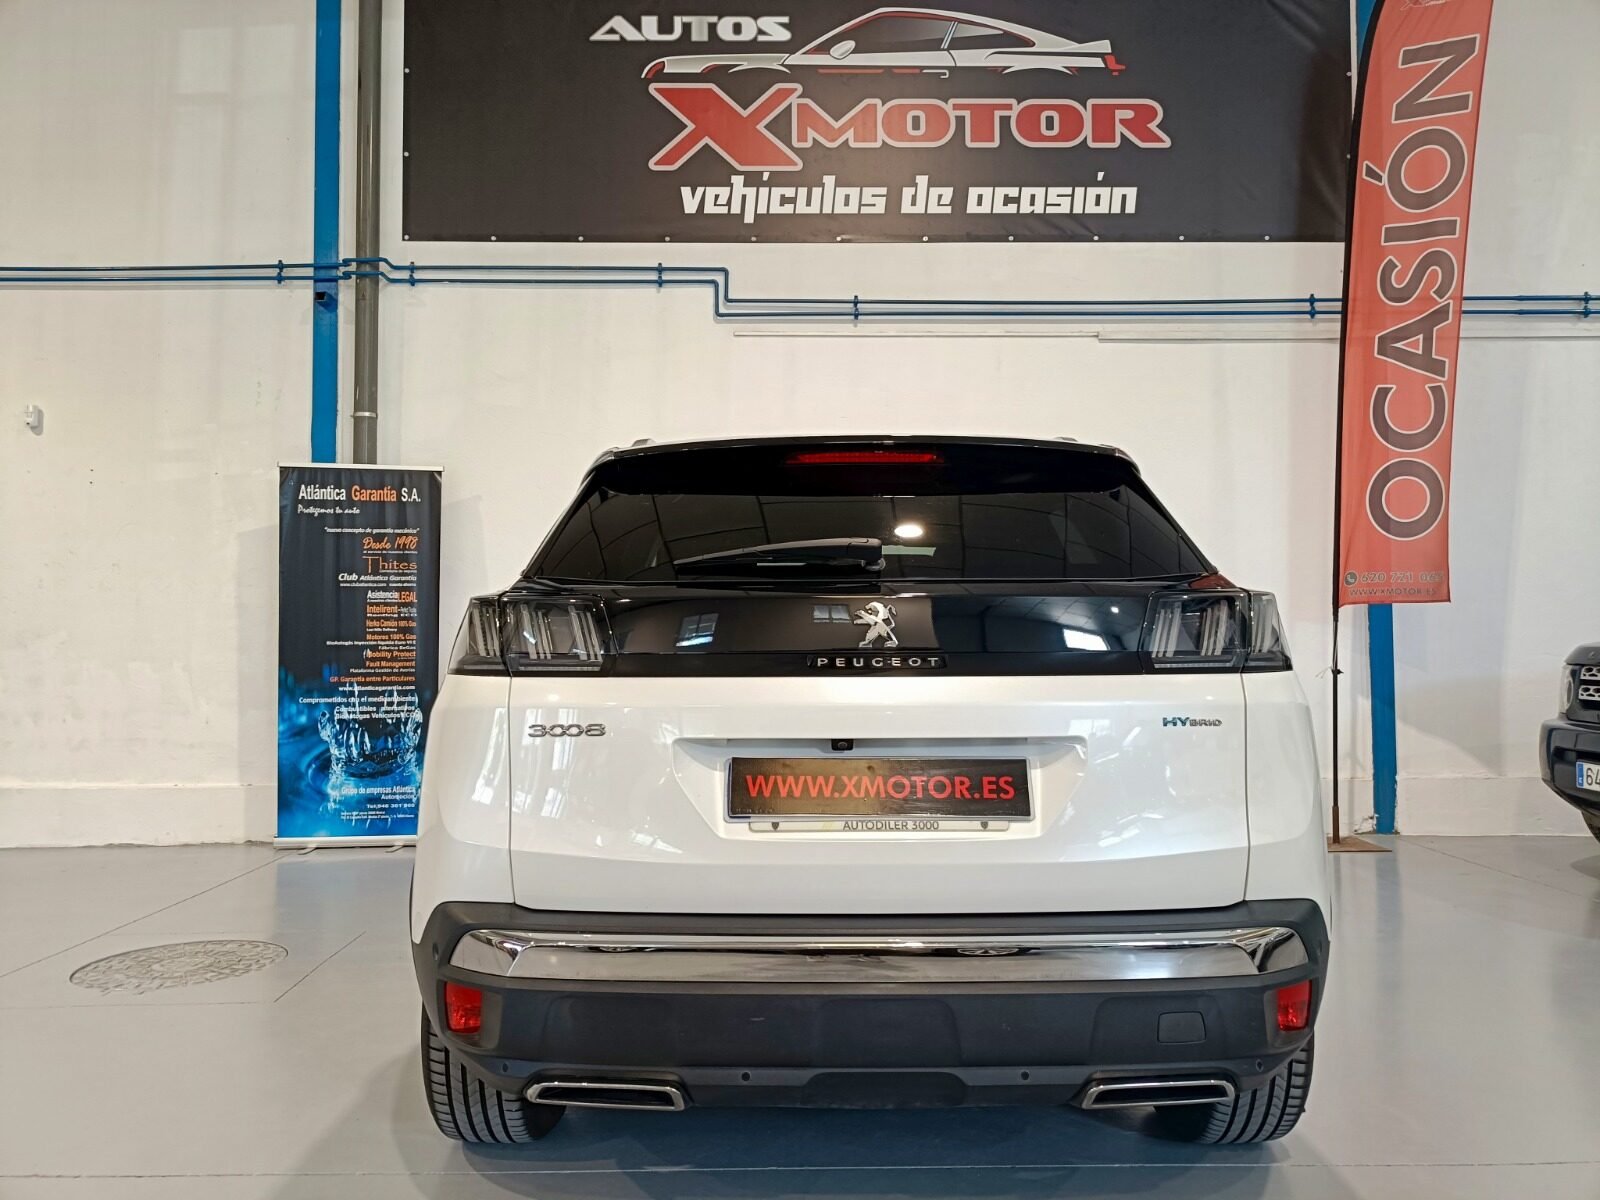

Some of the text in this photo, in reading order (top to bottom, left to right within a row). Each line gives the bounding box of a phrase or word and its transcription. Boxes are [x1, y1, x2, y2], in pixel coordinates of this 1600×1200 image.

[589, 15, 792, 43] AUTOS
[648, 82, 1172, 172] XMOTOR
[681, 171, 1138, 224] vehículos de ocasión
[1363, 33, 1481, 541] OCASIÓN
[298, 484, 421, 503] Atlántica Garantía S.A.
[362, 536, 419, 550] Desde 1998
[362, 556, 418, 574] Thites
[338, 572, 359, 581] Club
[367, 590, 417, 603] Asistencia LEGAL
[393, 651, 416, 659] Protect
[815, 656, 940, 668] PEUGEOT
[381, 661, 416, 669] Management
[340, 675, 365, 683] Garantía
[299, 696, 347, 704] Comprometidos
[1162, 716, 1223, 727] HYBRID
[527, 723, 607, 738] 3008
[366, 786, 393, 795] empresas
[745, 774, 1016, 801] WWW.XMOTOR.ES
[842, 819, 940, 833] AUTODILER 3000
